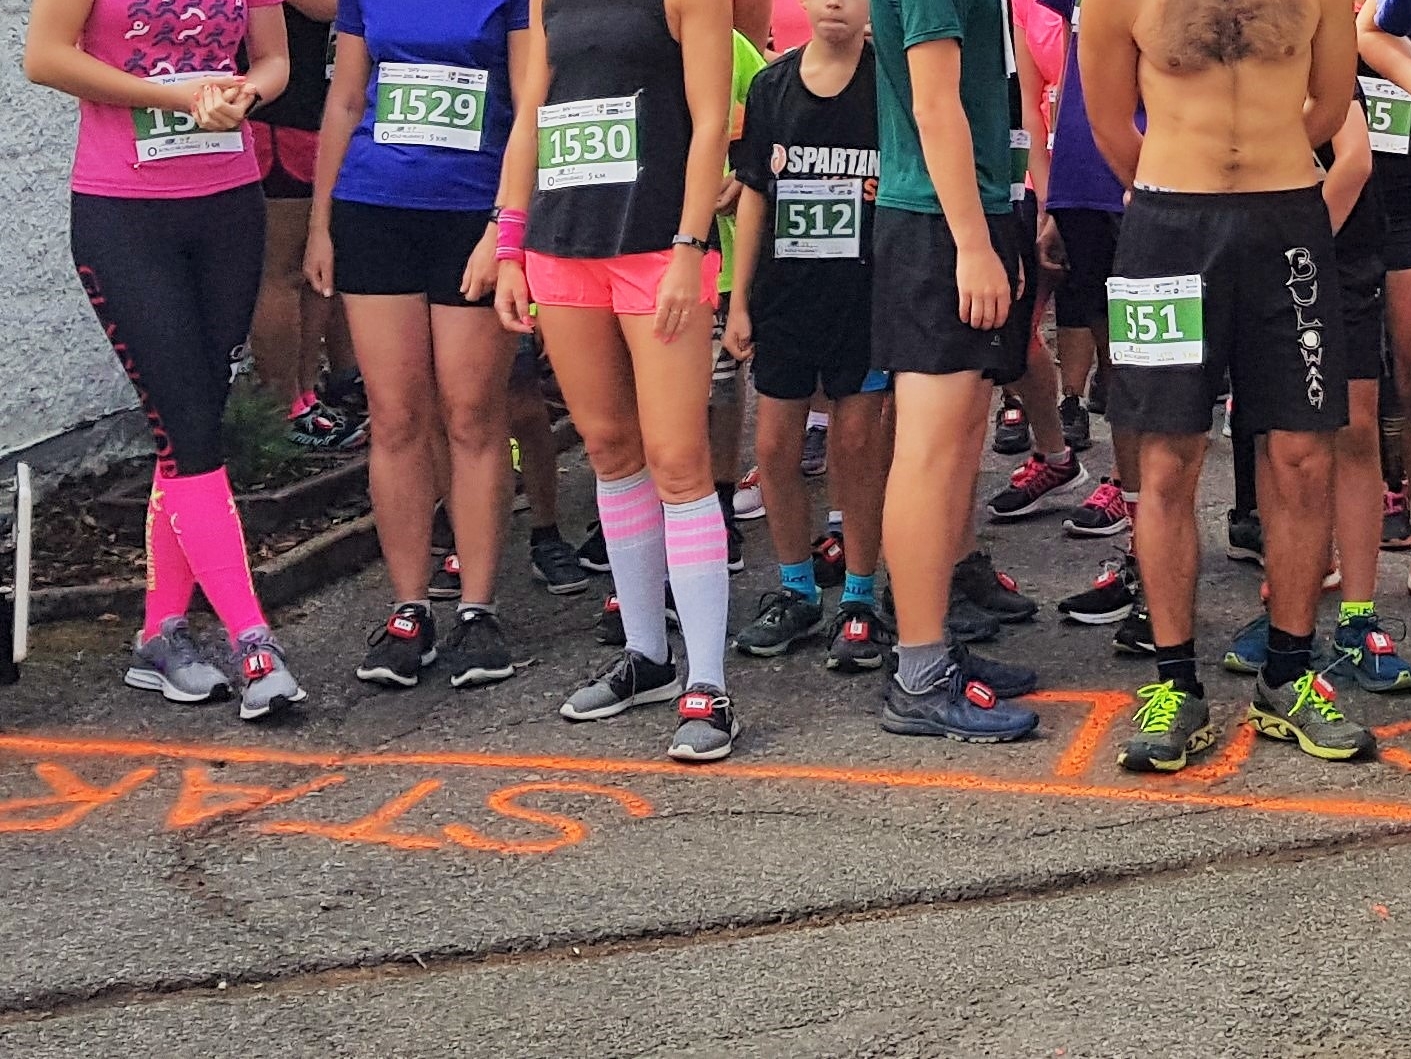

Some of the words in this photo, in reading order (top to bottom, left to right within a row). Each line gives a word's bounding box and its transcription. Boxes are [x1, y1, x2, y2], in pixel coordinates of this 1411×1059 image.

[146, 106, 197, 135] 15
[387, 87, 477, 126] 1529
[550, 124, 631, 164] 1530
[787, 145, 880, 177] SPARTAN
[788, 203, 853, 236] 512
[1125, 304, 1184, 341] 551
